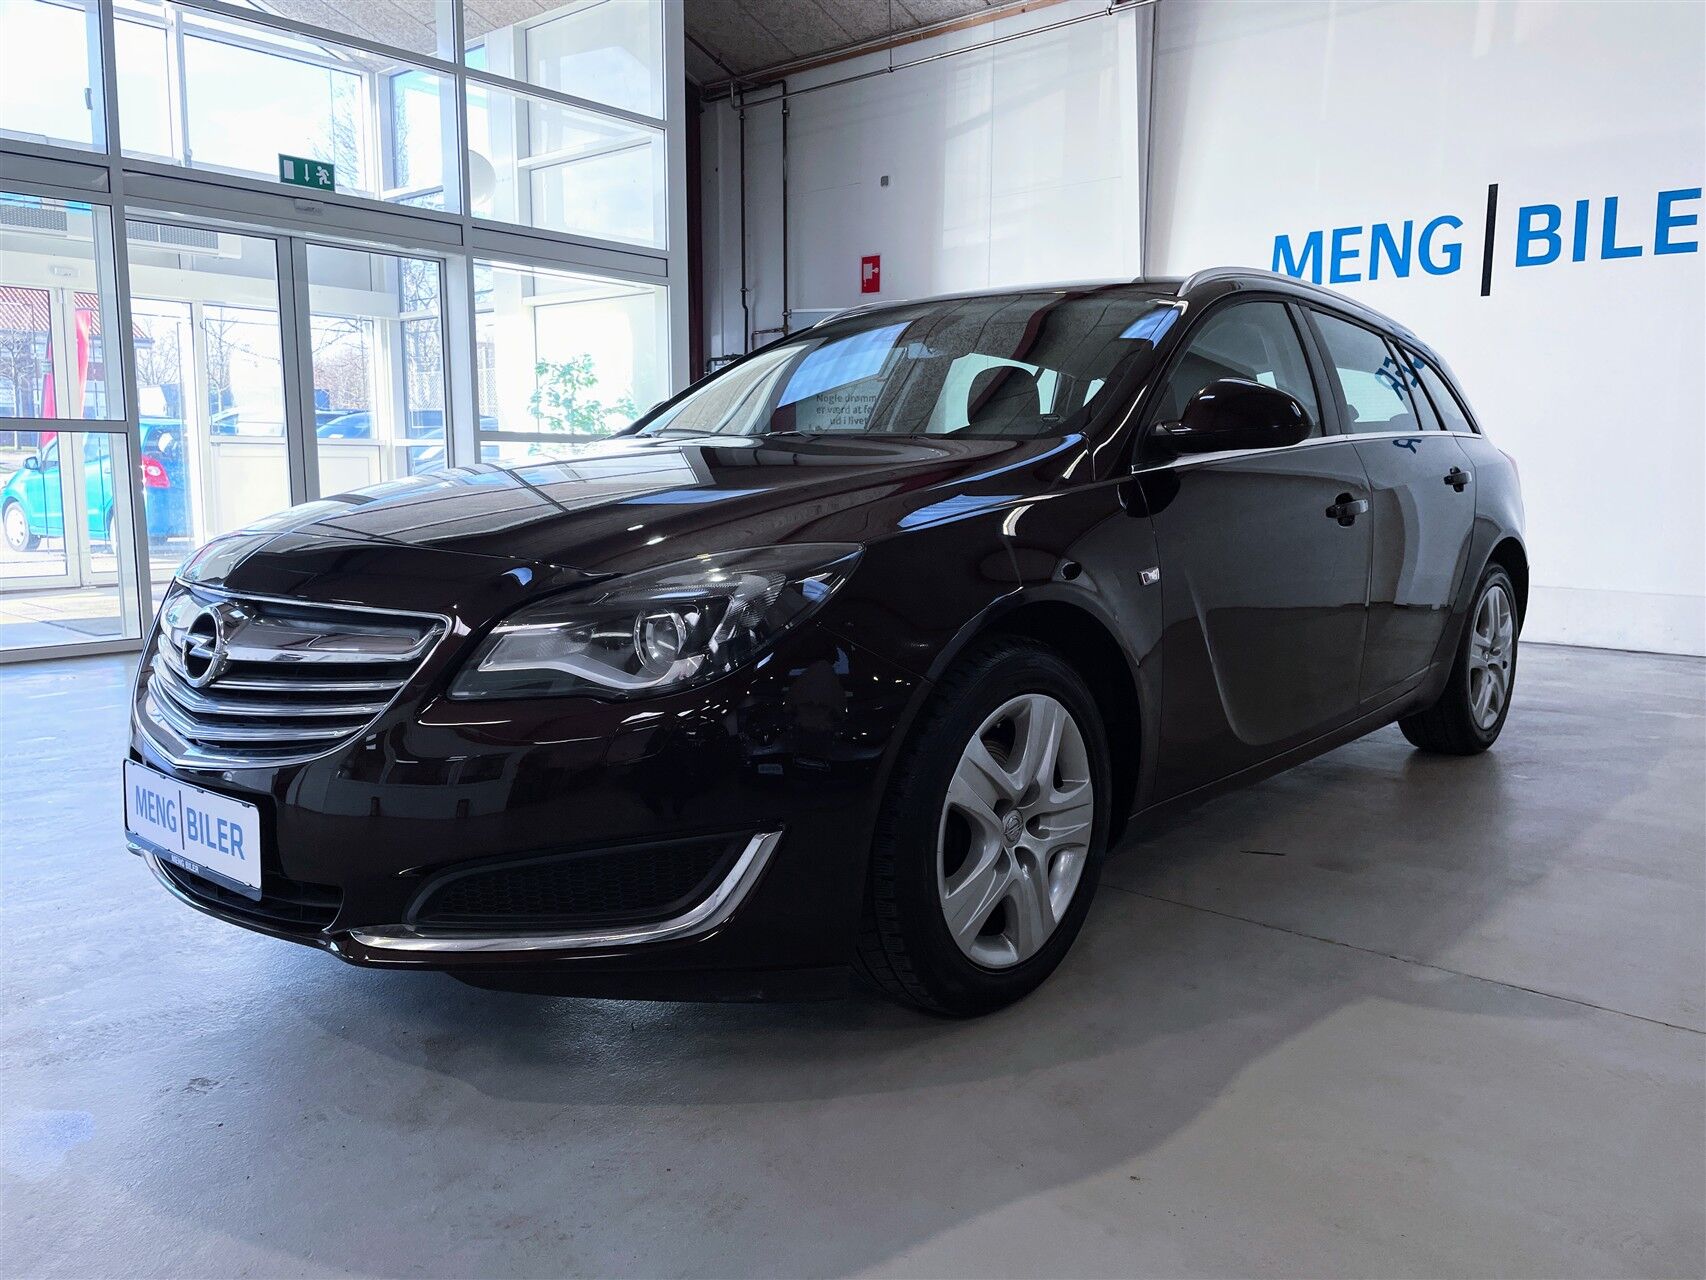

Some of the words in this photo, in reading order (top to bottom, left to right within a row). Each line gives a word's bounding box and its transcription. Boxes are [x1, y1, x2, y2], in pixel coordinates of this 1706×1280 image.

[1272, 214, 1463, 285] MENG
[816, 394, 842, 404] Nogle
[853, 406, 861, 414] at
[830, 417, 841, 425] ud
[135, 785, 177, 833] MENG
[186, 806, 246, 860] BILER
